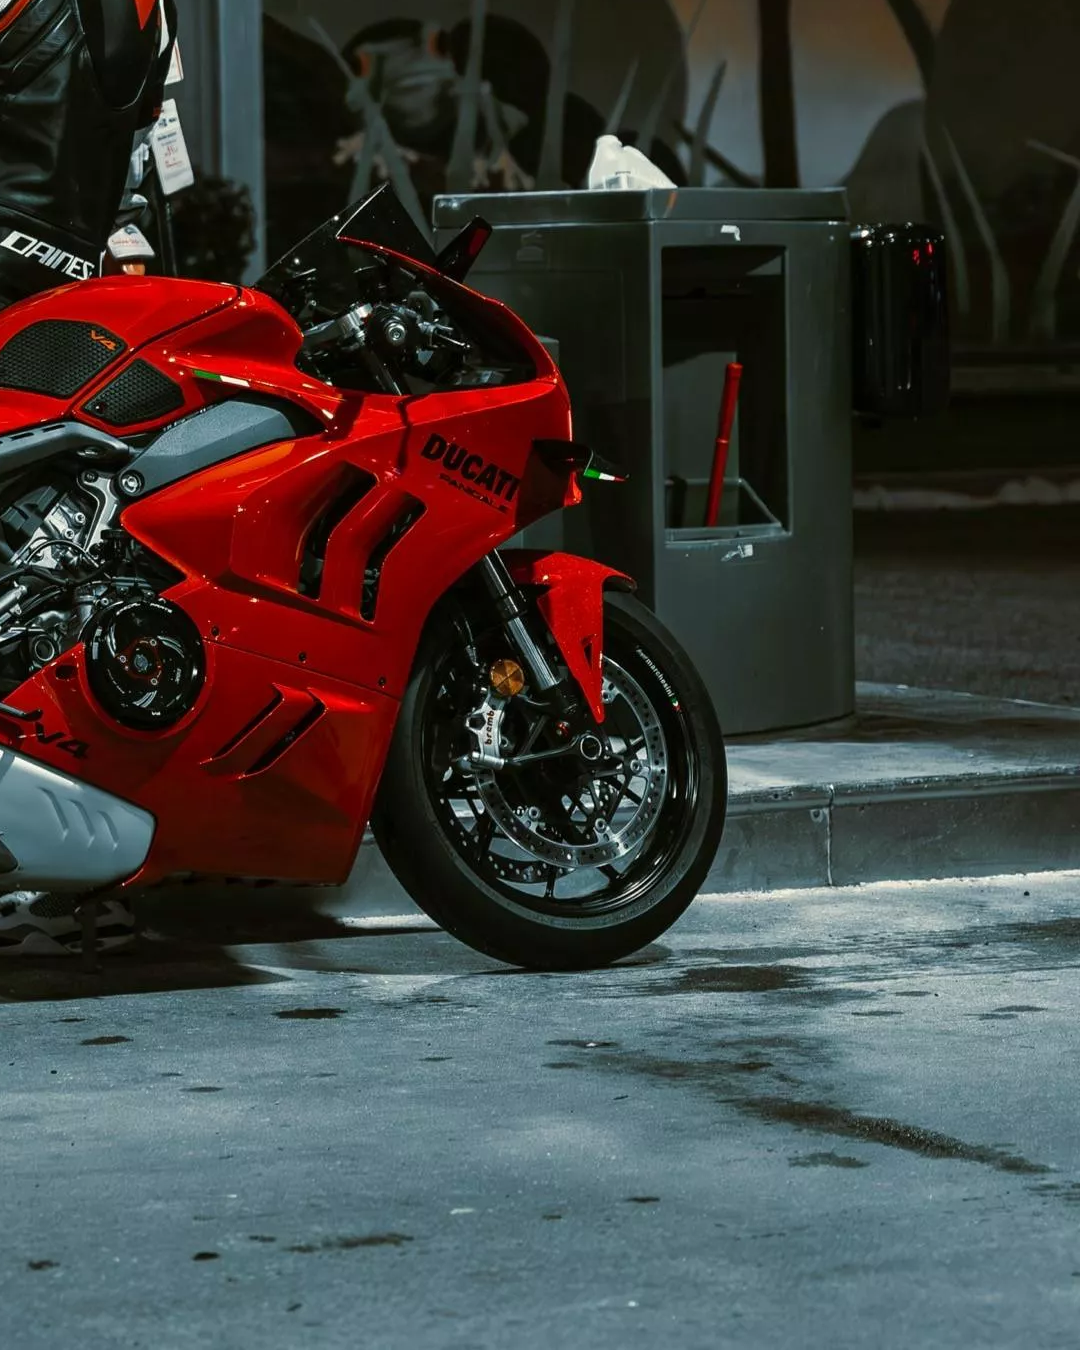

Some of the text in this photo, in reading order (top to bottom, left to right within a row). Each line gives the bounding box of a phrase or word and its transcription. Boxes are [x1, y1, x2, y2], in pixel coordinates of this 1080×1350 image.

[0, 231, 95, 280] DAINES
[90, 330, 118, 351] V4
[421, 433, 520, 502] DUCATI
